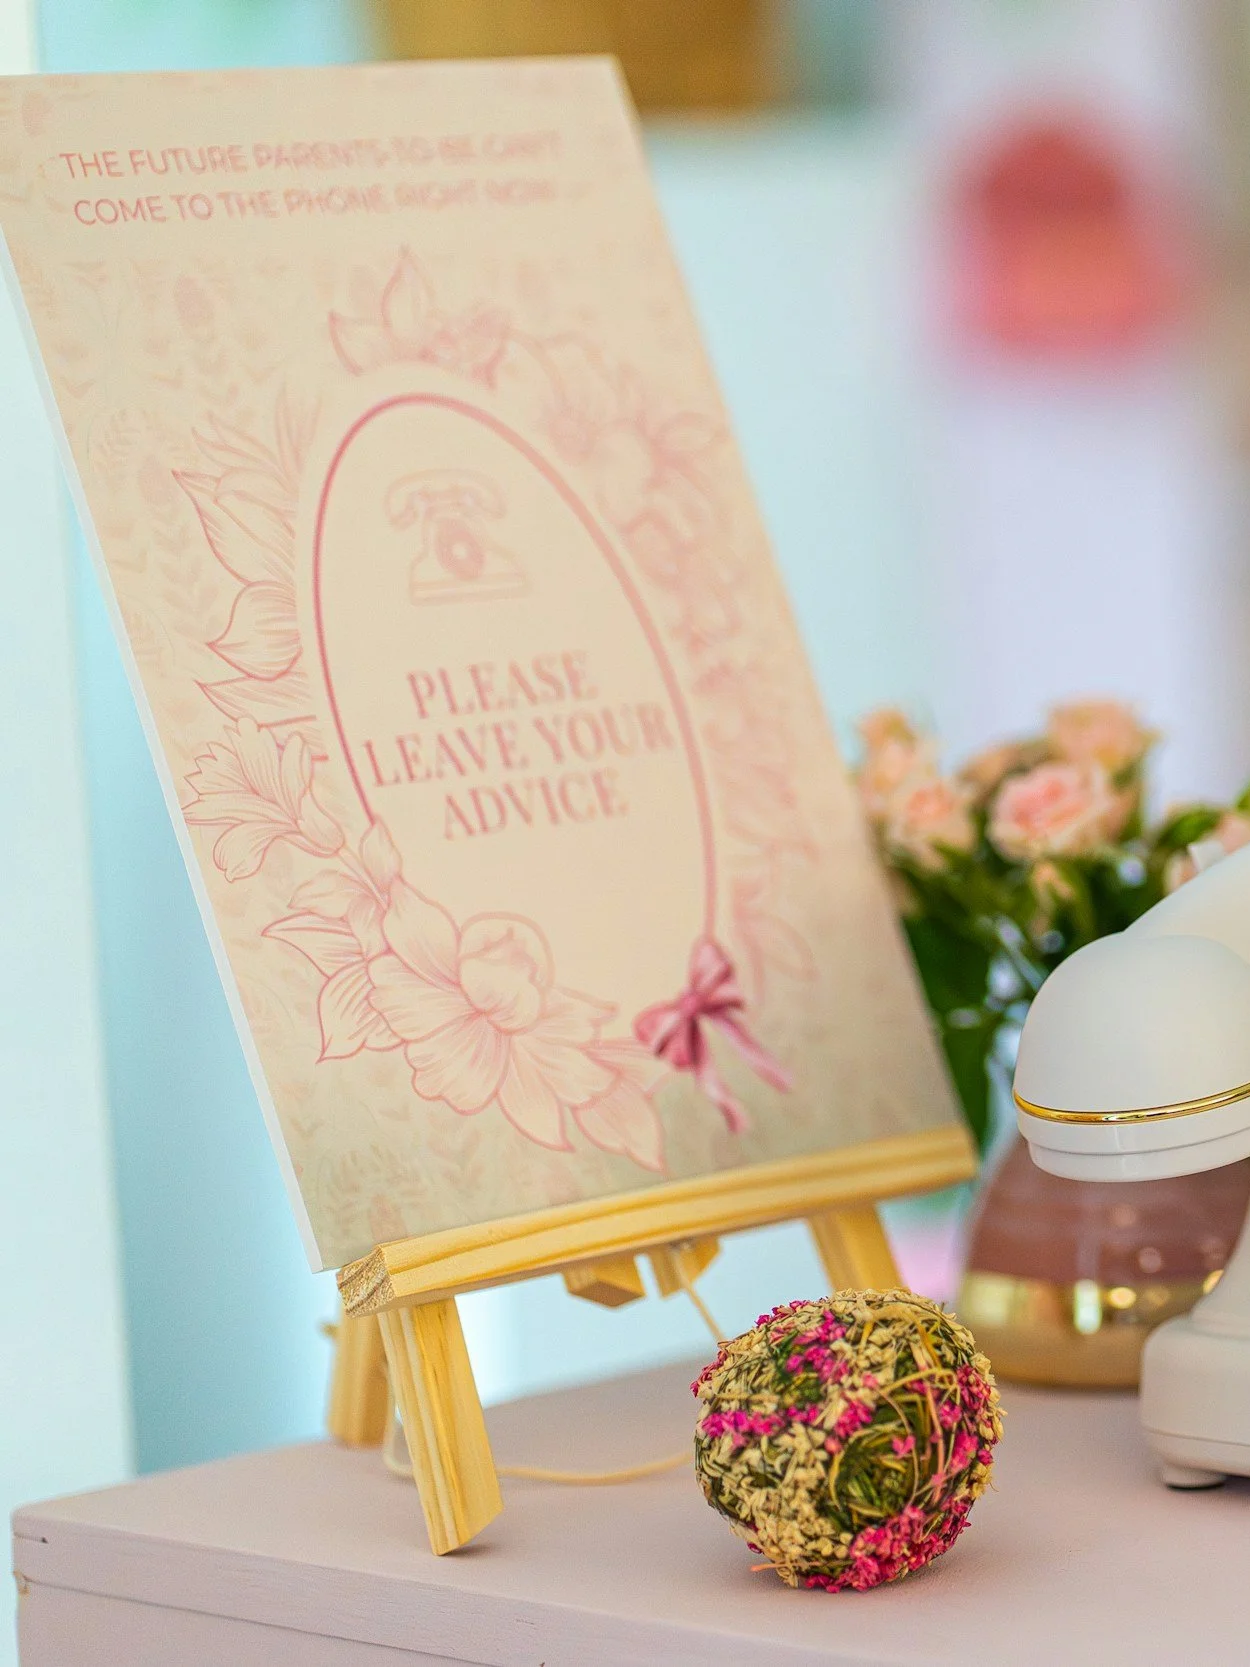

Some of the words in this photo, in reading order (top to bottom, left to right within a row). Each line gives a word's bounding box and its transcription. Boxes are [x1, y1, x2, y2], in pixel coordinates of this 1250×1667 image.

[60, 149, 124, 179] THE
[129, 144, 248, 176] FUTURE
[74, 196, 168, 226] COME
[170, 193, 215, 221] TO
[216, 190, 280, 219] THE
[407, 651, 598, 719] PLEASE
[363, 718, 530, 788] LEAVE
[533, 702, 675, 764] YOUR
[443, 768, 630, 841] ADVICE
